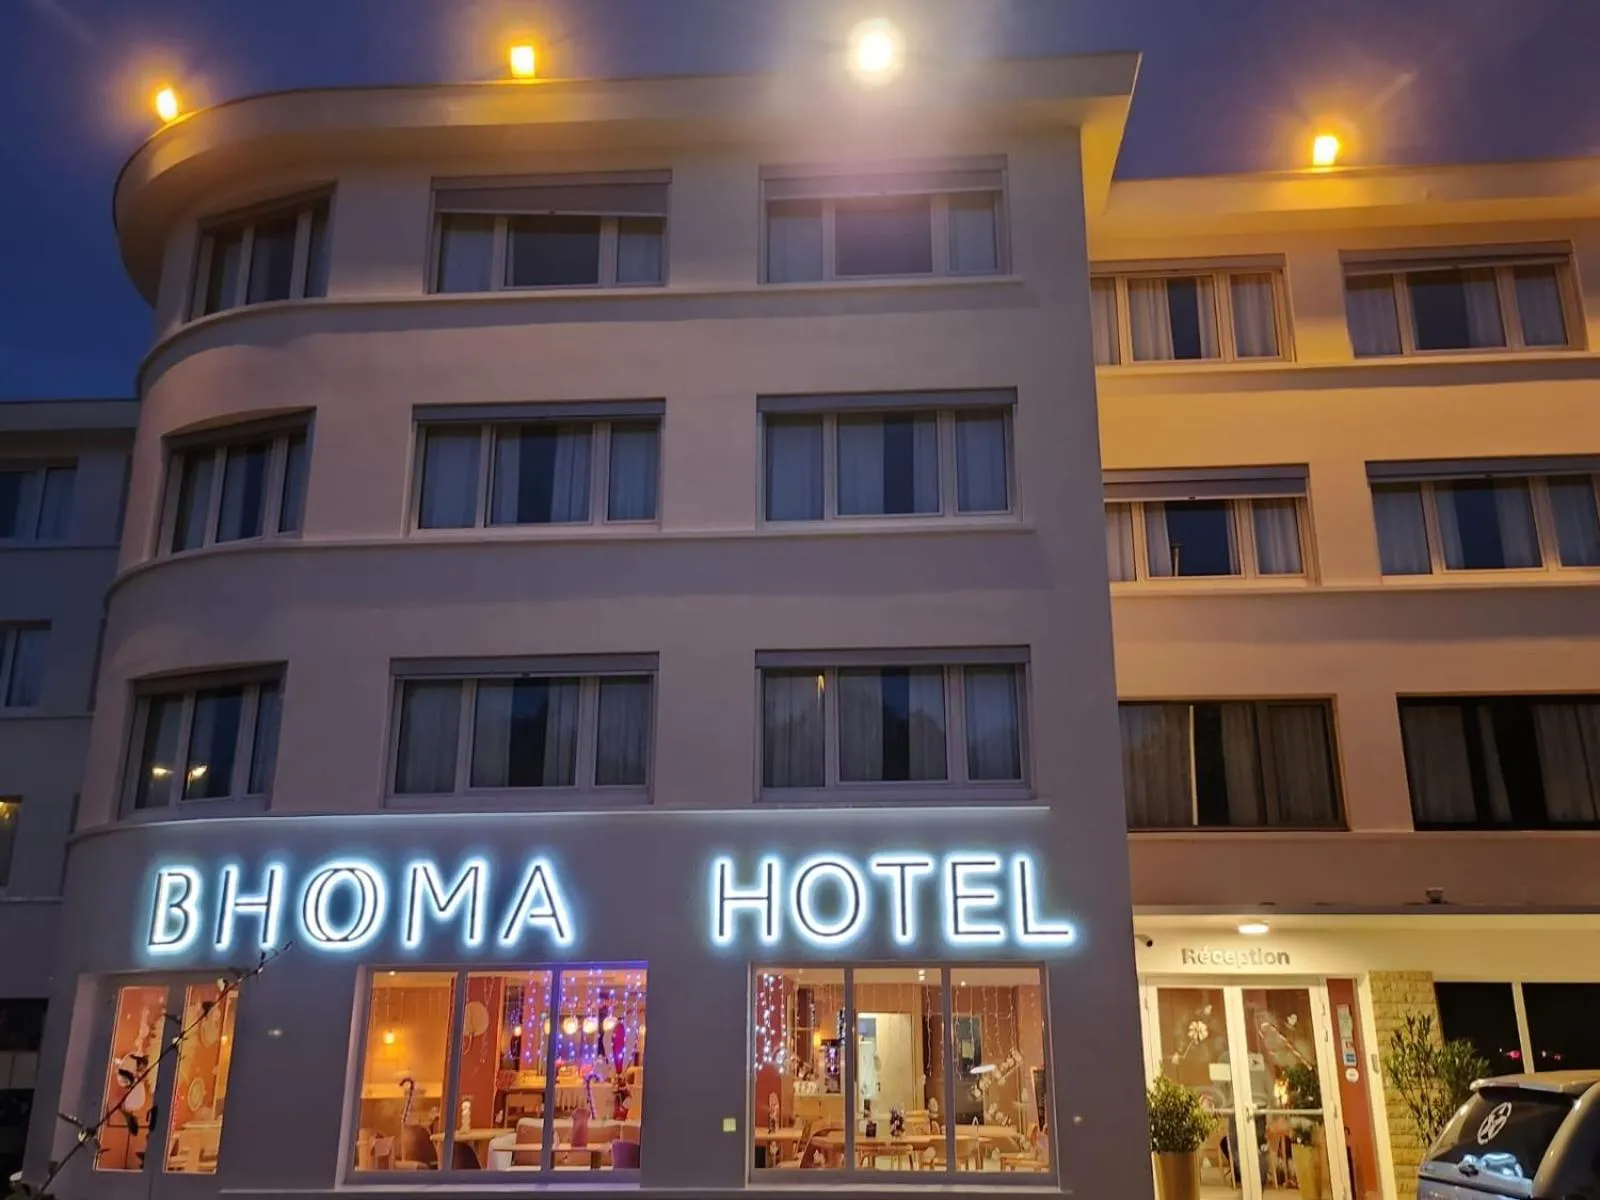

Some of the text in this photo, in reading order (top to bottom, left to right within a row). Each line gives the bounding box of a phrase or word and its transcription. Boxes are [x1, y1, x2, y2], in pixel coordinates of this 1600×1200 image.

[146, 856, 1073, 950] BHOMA HOTEL
[1181, 945, 1291, 968] Réception
